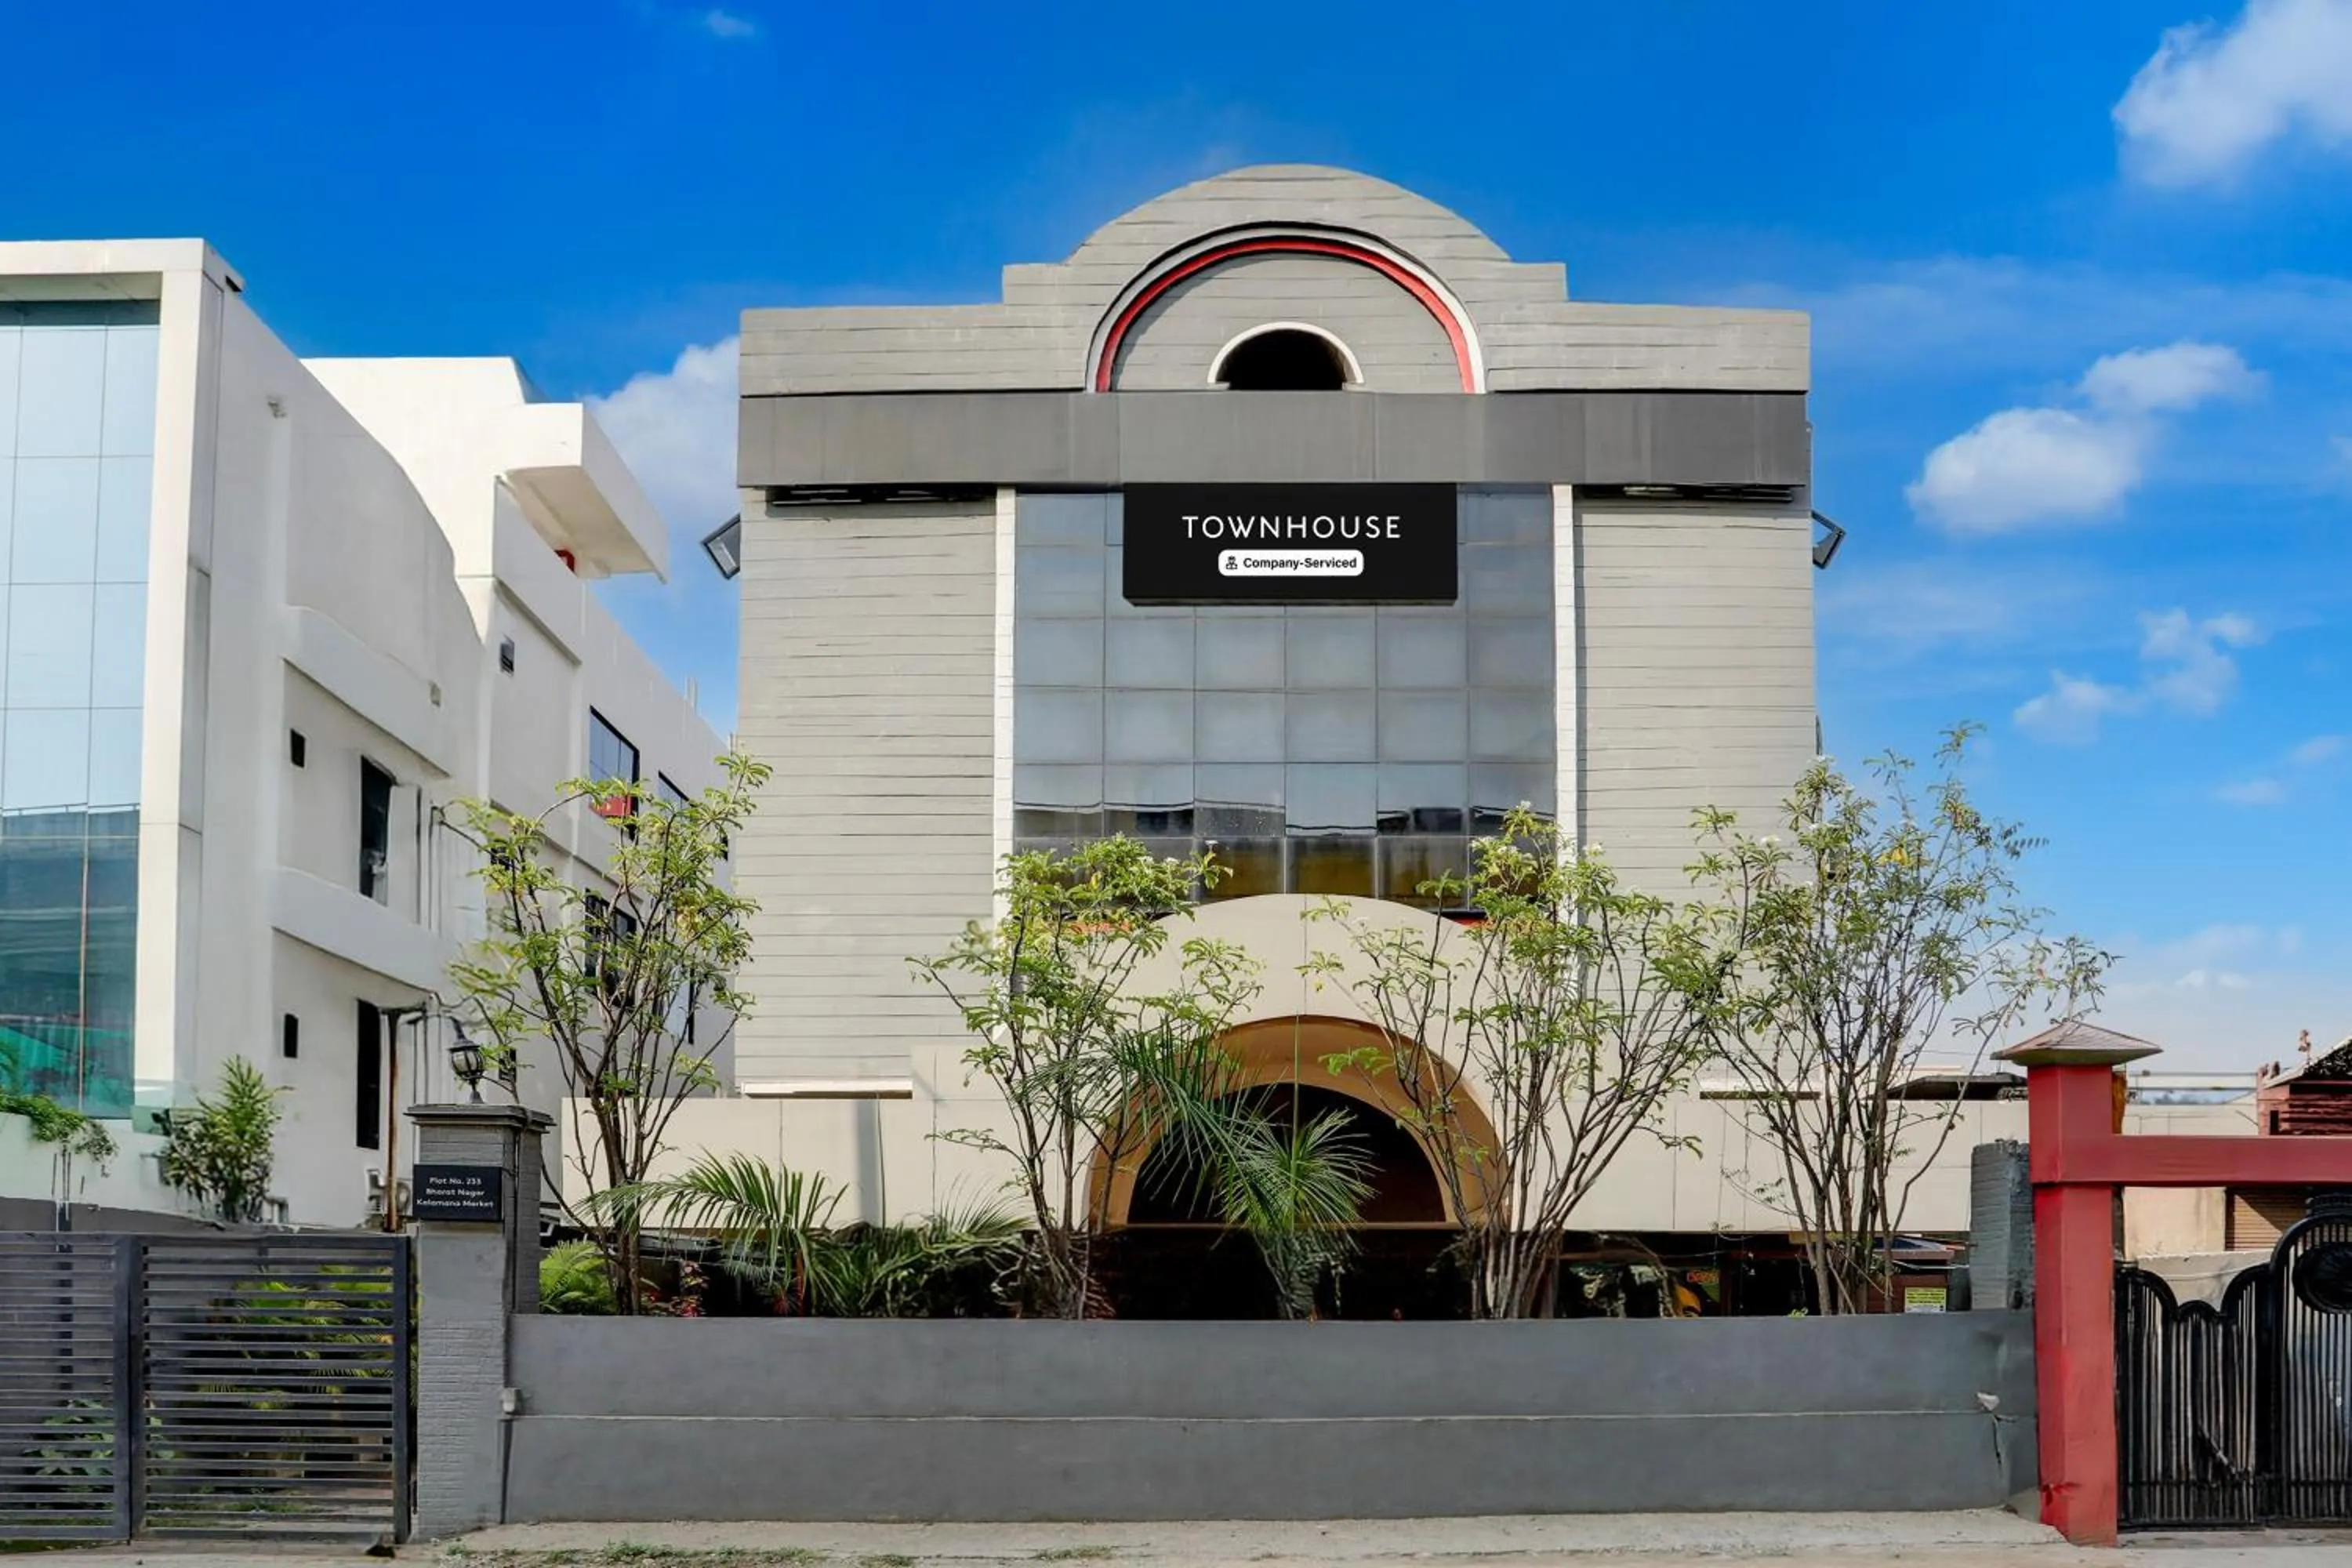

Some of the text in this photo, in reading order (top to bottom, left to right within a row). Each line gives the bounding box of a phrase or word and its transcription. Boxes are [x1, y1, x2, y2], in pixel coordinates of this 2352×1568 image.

[1181, 515, 1401, 539] TOWNHOUSE
[1243, 557, 1357, 571] Company-Serviced
[457, 1189, 485, 1198] Nagar
